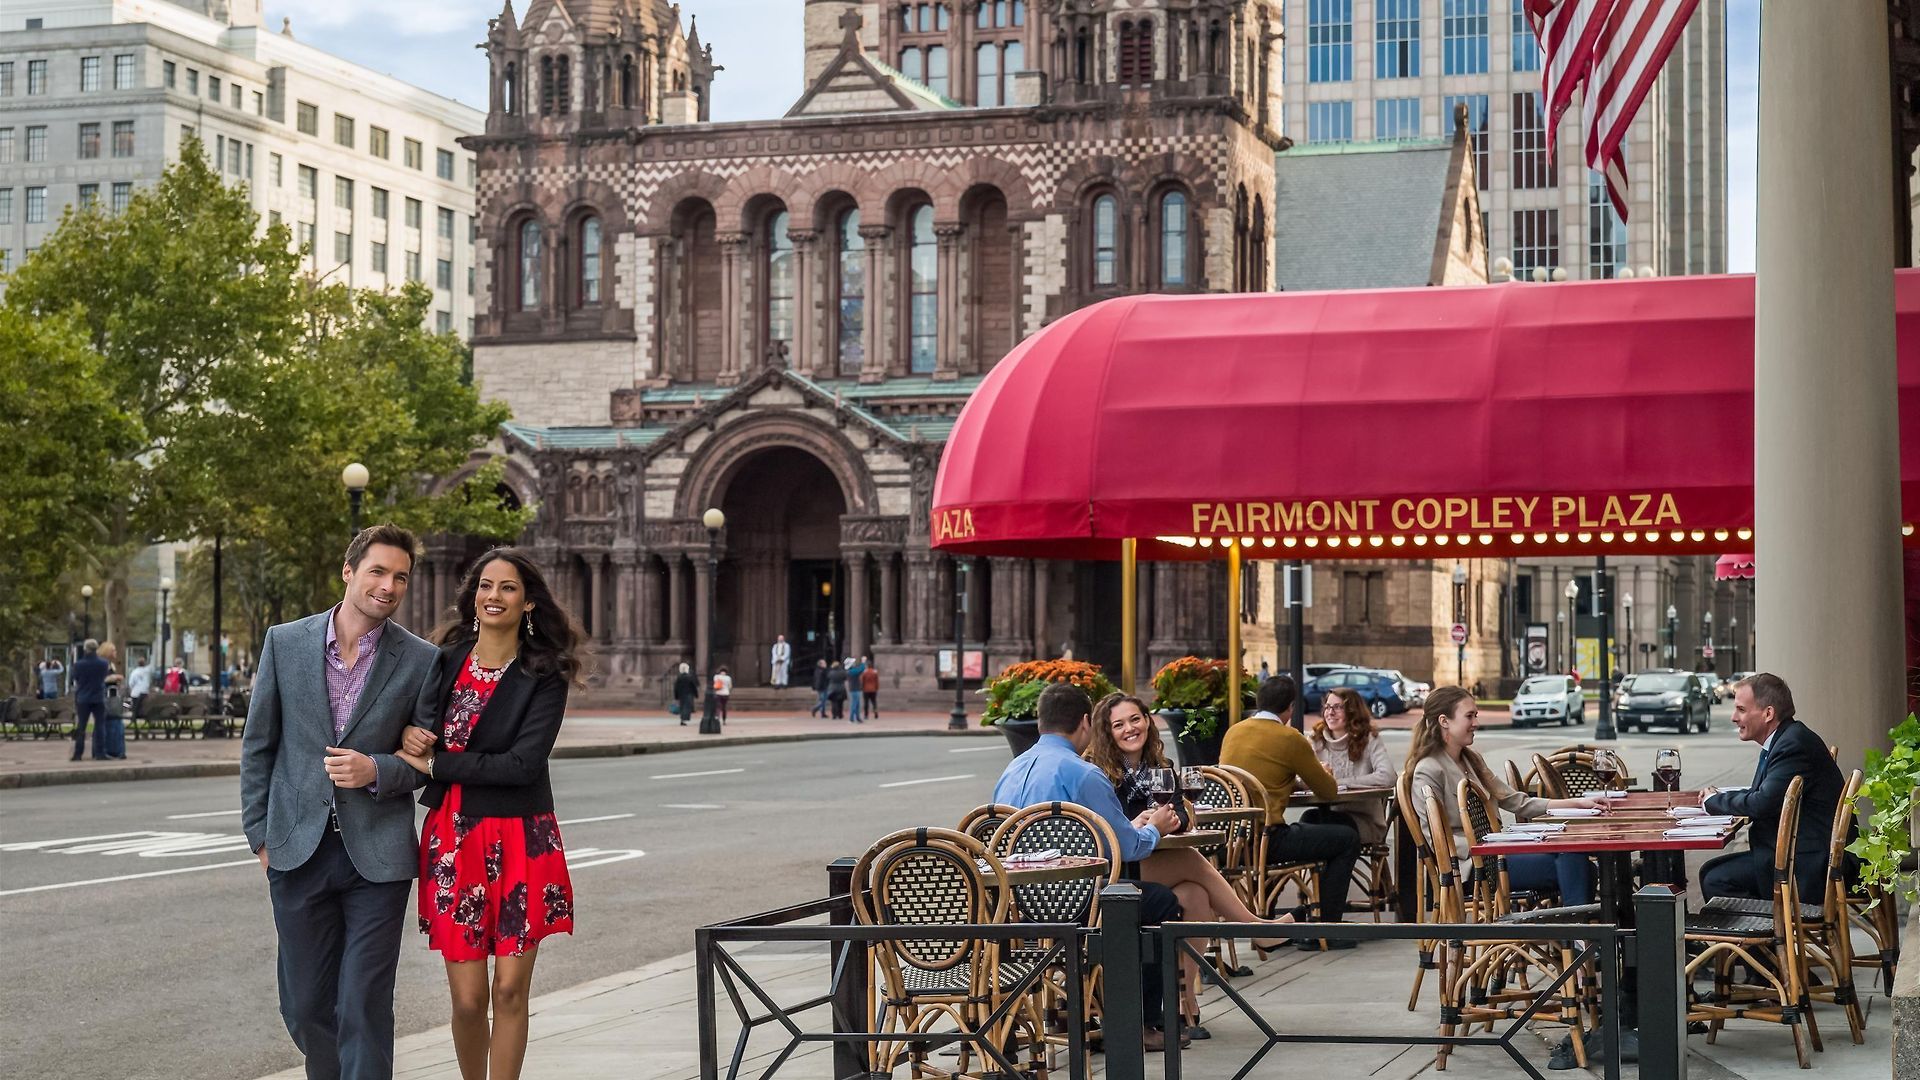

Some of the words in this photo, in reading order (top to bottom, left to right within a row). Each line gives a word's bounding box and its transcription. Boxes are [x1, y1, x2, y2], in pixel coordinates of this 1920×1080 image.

[1192, 500, 1380, 533] FAIRMONT
[1391, 496, 1539, 529] COPLEY
[1552, 493, 1681, 527] PLAZA
